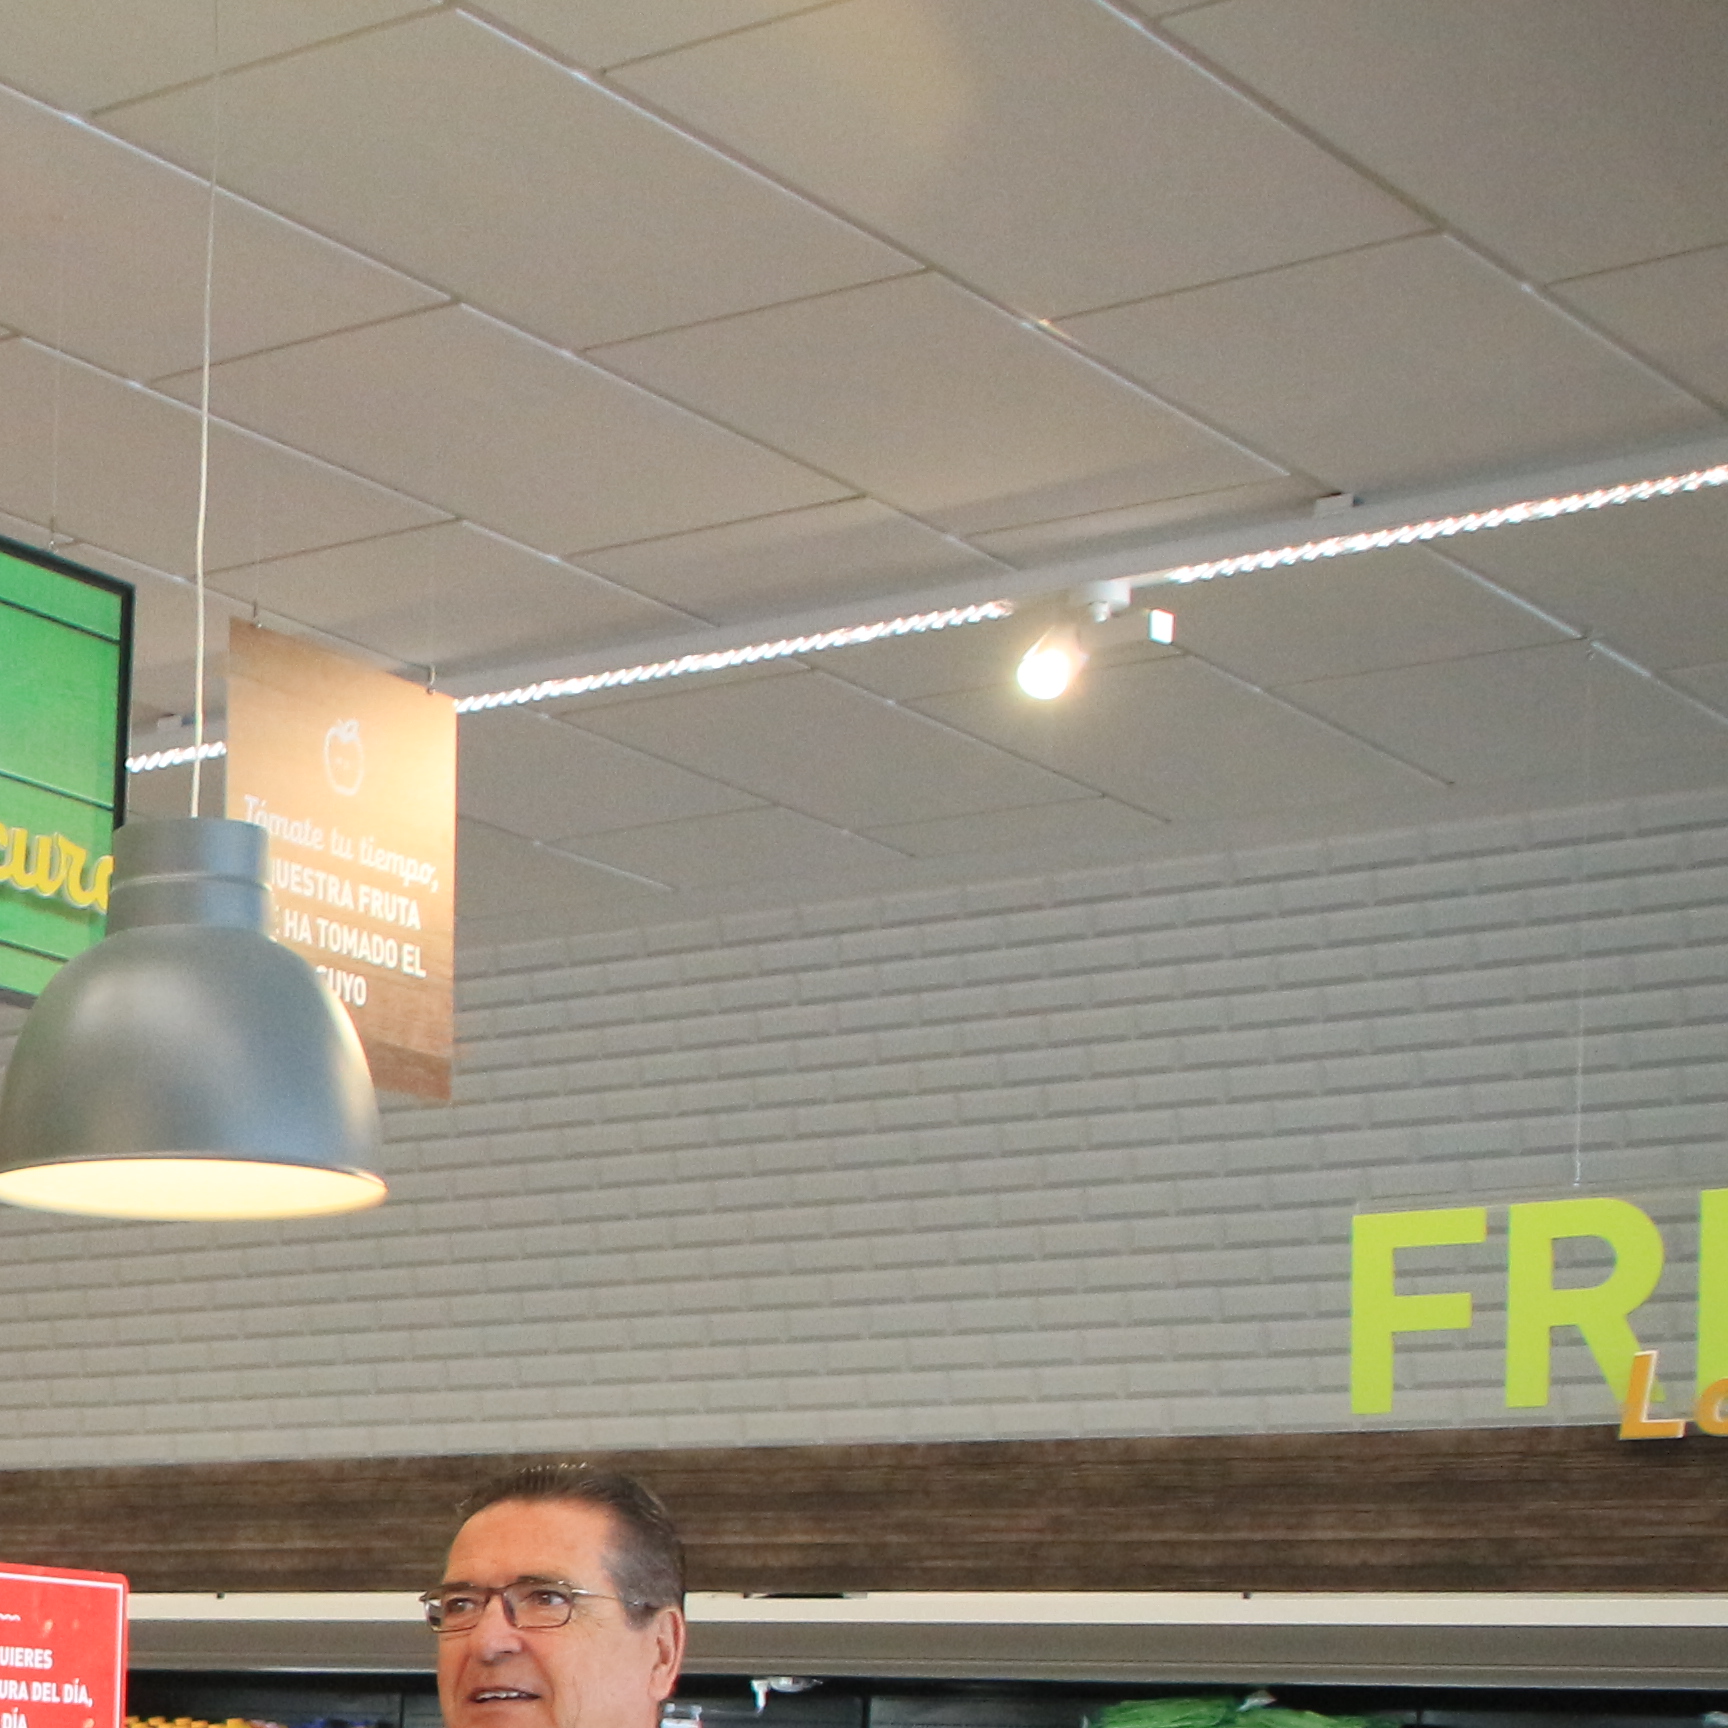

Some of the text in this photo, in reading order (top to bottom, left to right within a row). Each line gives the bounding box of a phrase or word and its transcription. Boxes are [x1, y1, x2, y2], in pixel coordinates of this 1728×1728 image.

[331, 828, 354, 861] tu
[358, 885, 422, 931] FRUTA
[283, 905, 427, 979] HA TOMADO EL
[1350, 1188, 1728, 1415] FR
[31, 1681, 61, 1703] DEL
[63, 1678, 93, 1707] DÍA,
